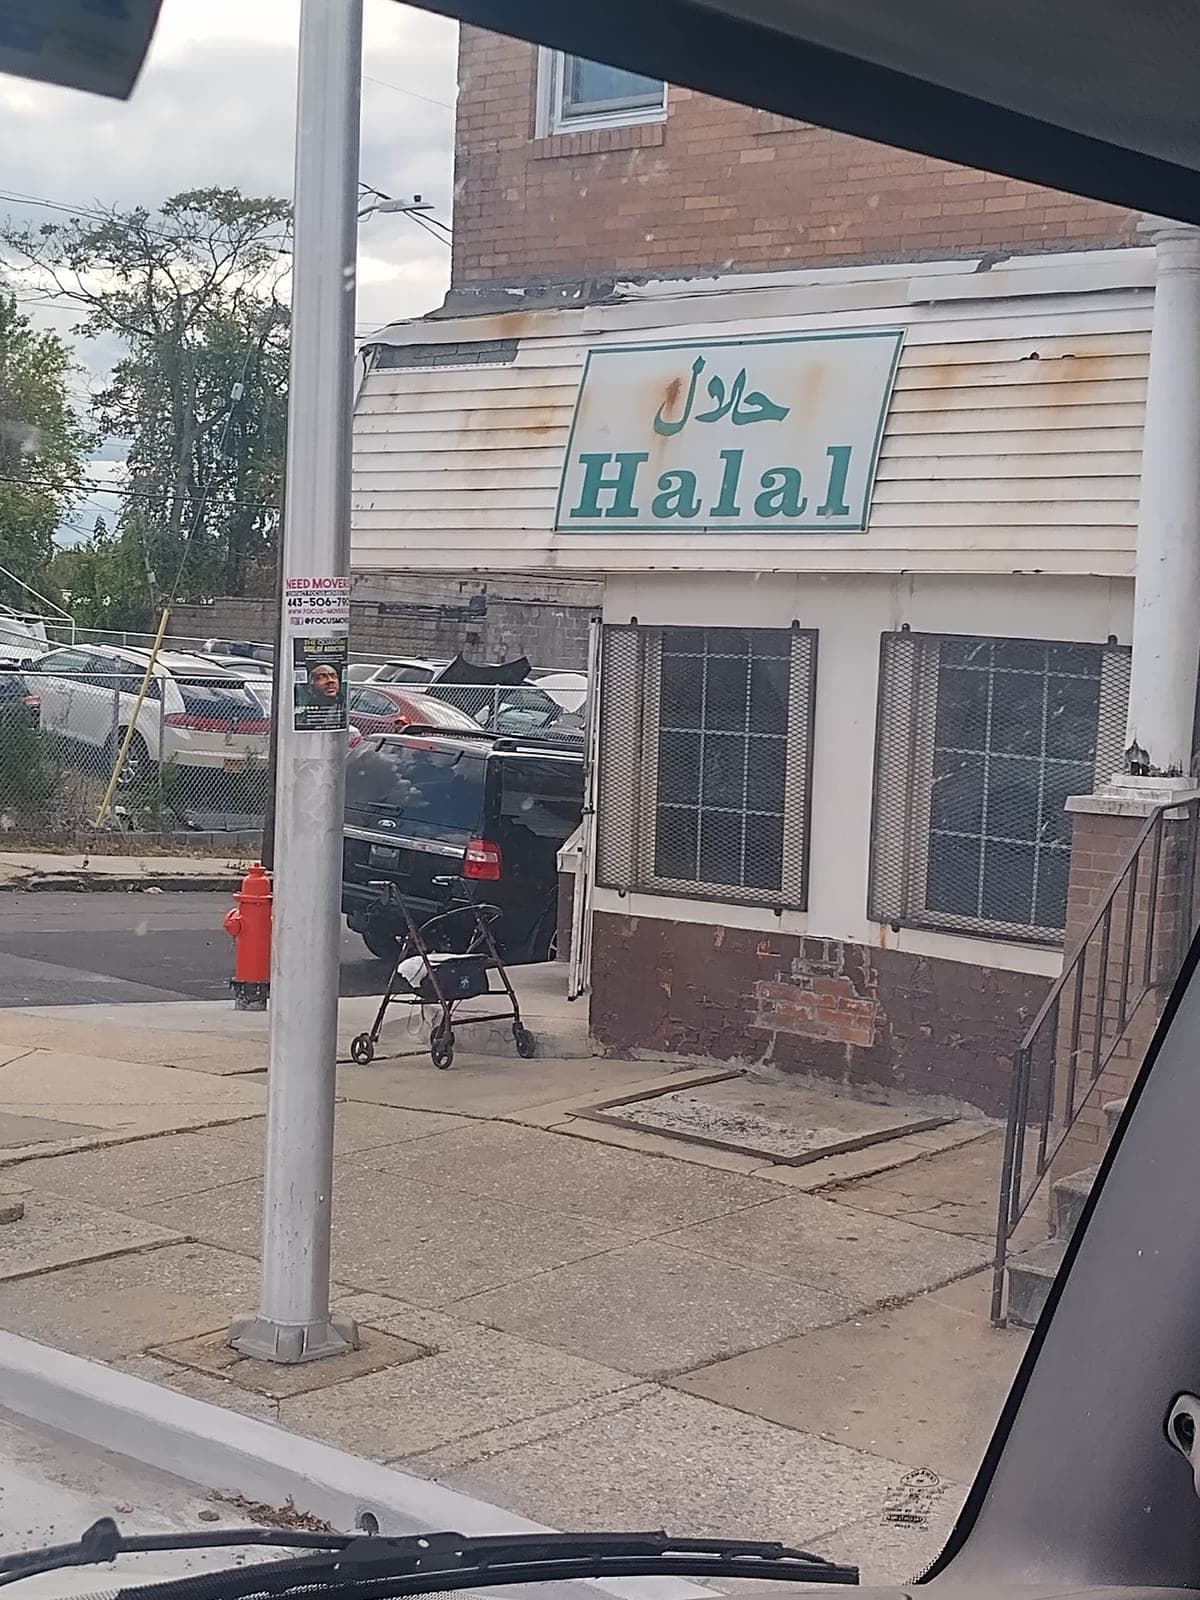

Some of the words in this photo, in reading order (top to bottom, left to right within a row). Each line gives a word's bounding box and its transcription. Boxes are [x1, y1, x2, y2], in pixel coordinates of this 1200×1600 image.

[653, 354, 791, 436] حلال
[569, 444, 853, 519] Halal
[286, 578, 311, 589] NEED
